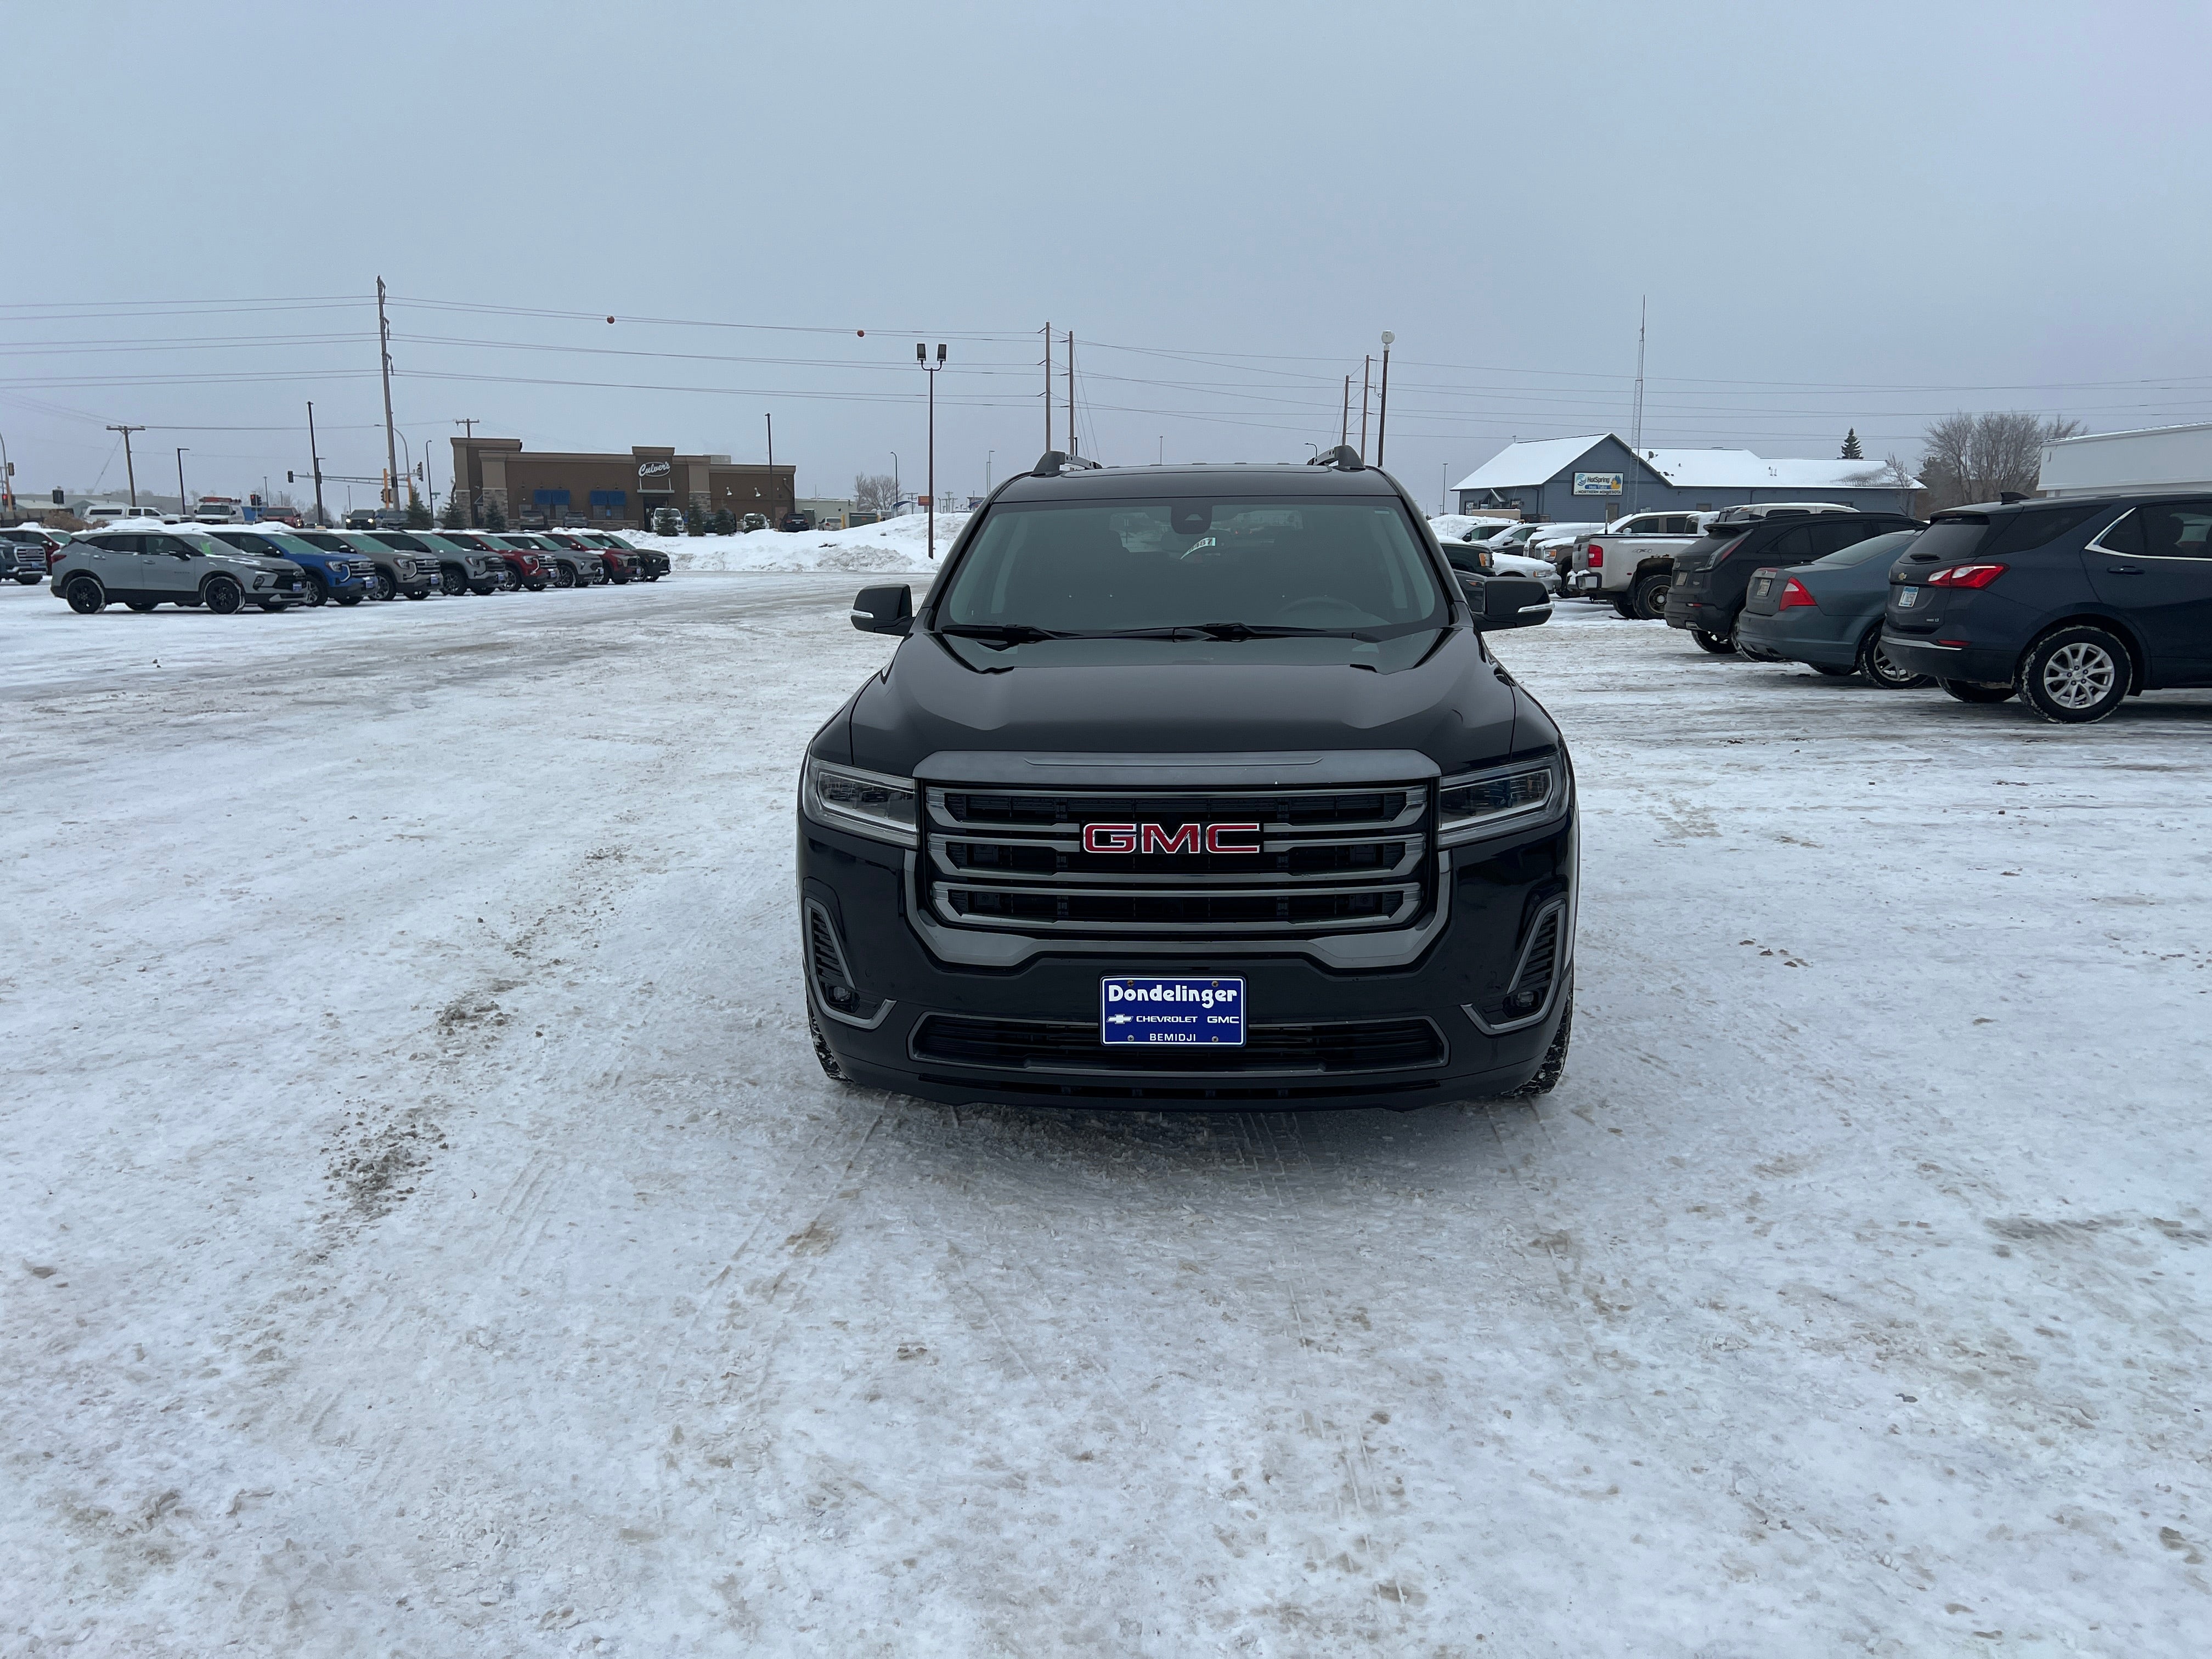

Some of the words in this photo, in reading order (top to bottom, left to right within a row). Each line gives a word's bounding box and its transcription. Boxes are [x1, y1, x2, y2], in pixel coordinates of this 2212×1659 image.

[638, 461, 670, 477] Culver's
[1083, 823, 1260, 854] GMC
[1108, 985, 1237, 1008] Dondelinger
[1149, 1033, 1196, 1041] BEMIDJI
